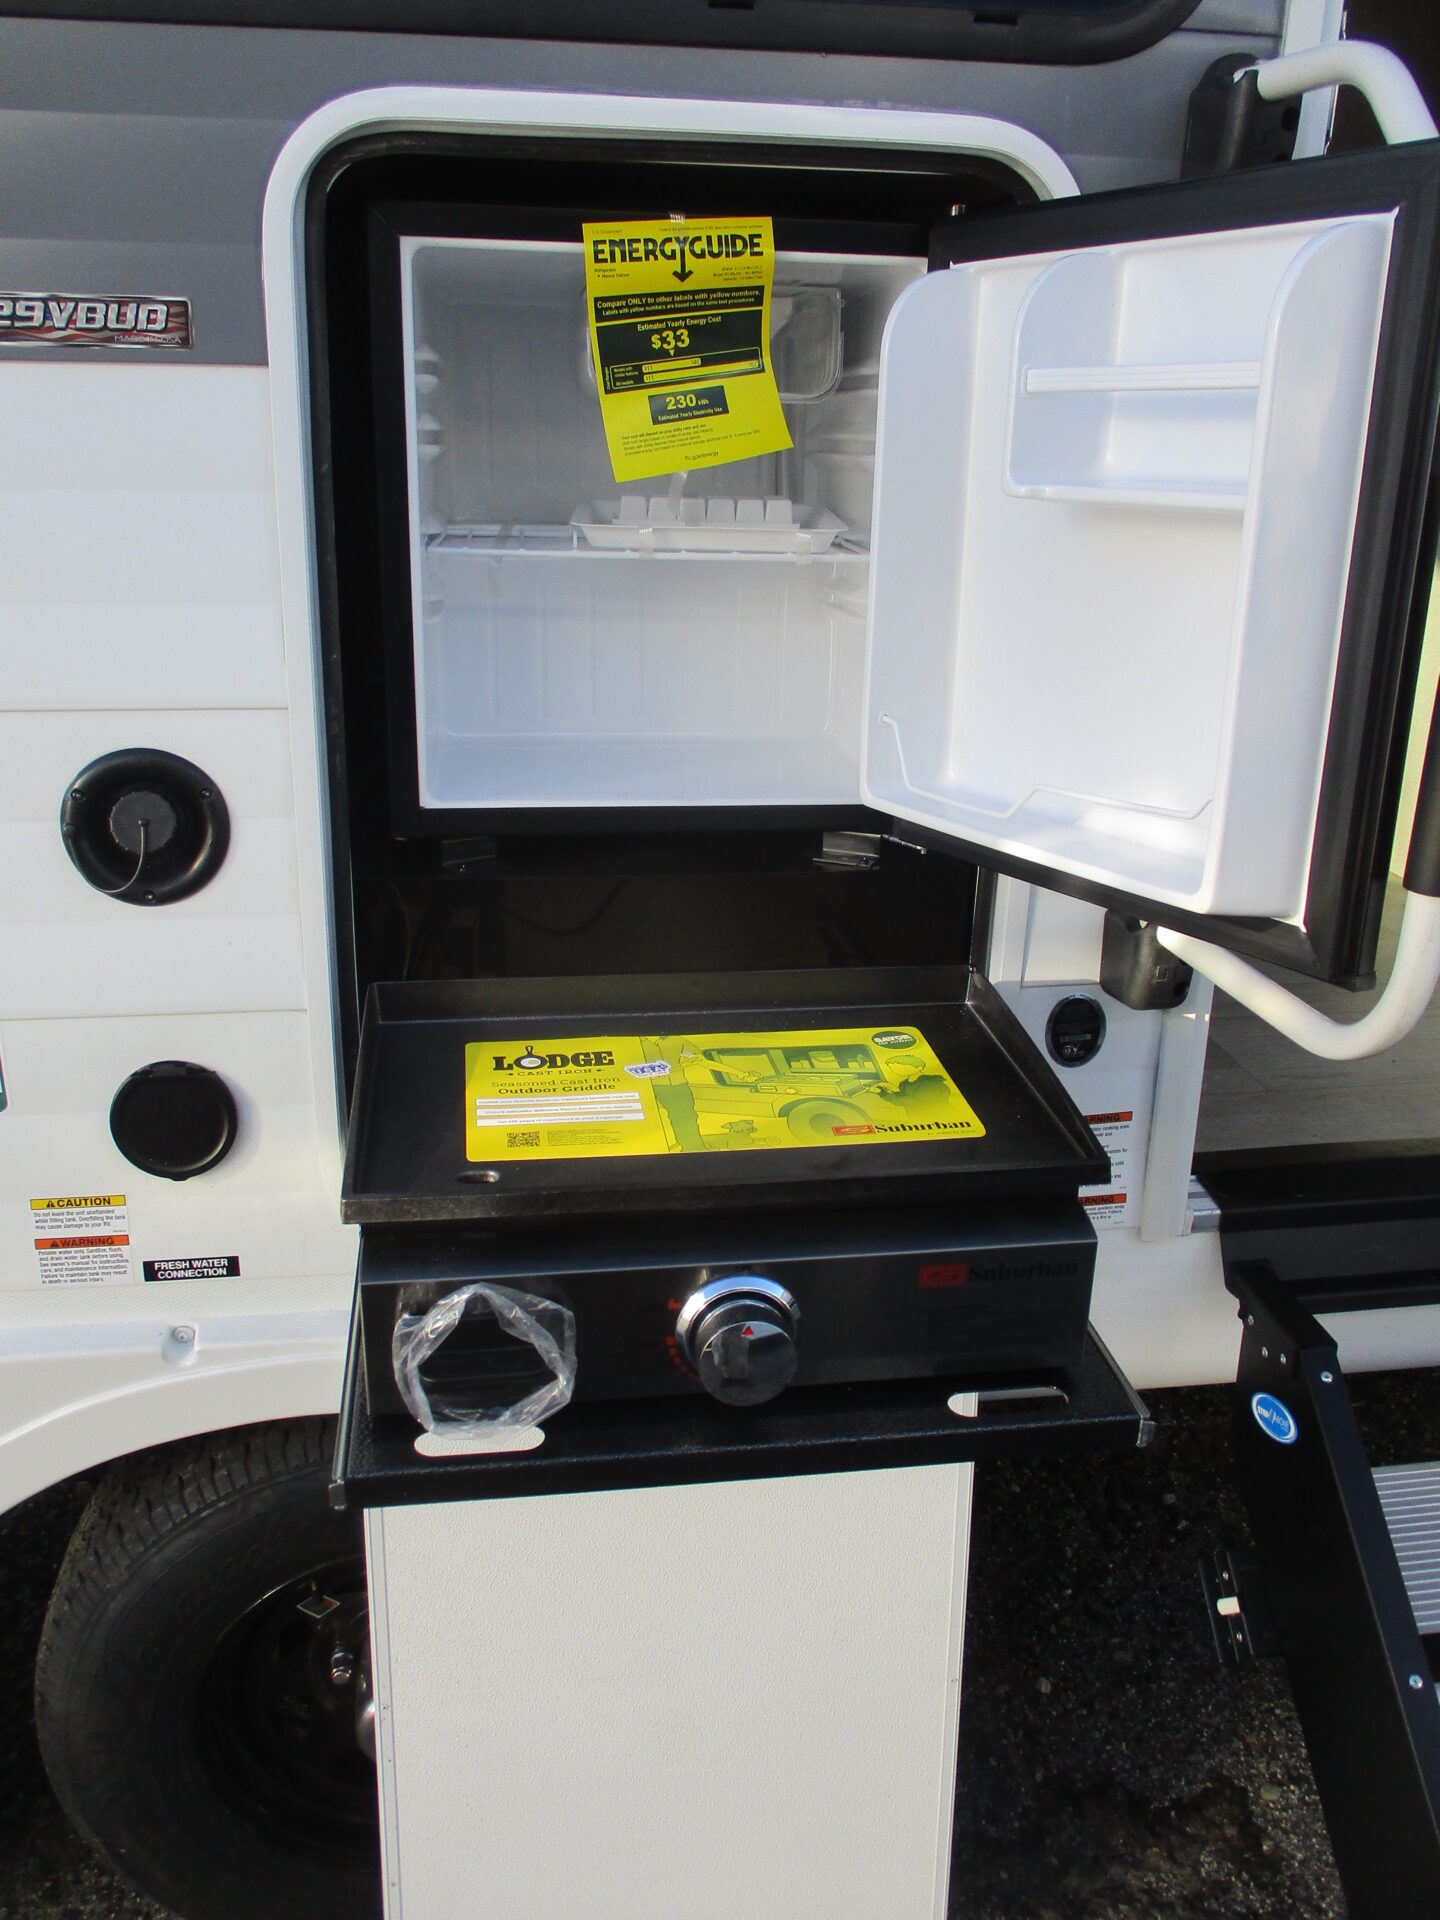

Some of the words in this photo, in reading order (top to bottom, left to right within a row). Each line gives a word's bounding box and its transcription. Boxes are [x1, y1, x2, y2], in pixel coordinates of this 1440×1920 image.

[593, 233, 764, 270] ENERGYGUIDE
[597, 300, 627, 309] Compare
[628, 297, 646, 306] ONLY
[694, 292, 708, 300] with
[709, 291, 731, 300] yellow
[630, 306, 645, 314] yellow
[637, 321, 667, 332] Estimated
[667, 319, 685, 329] Yearly
[686, 317, 707, 328] Energy
[708, 315, 722, 324] Cost
[651, 328, 690, 350] $33
[665, 393, 697, 410] 230
[657, 412, 680, 422] Estimated
[680, 411, 693, 419] Yearly
[692, 408, 714, 417] Electricity
[492, 1046, 615, 1071] LODGE
[491, 1079, 556, 1088] Seasoned
[560, 1077, 589, 1085] Cast
[498, 1085, 558, 1095] Outdoor
[562, 1083, 616, 1093] Griddle
[875, 1121, 972, 1134] Suburban
[57, 1197, 111, 1208] CAUTION
[60, 1237, 115, 1248] WARNING
[154, 1261, 190, 1271] FRESH
[191, 1258, 228, 1268] WATER
[157, 1267, 227, 1279] CONNECTION
[968, 1261, 1079, 1283] Suburban
